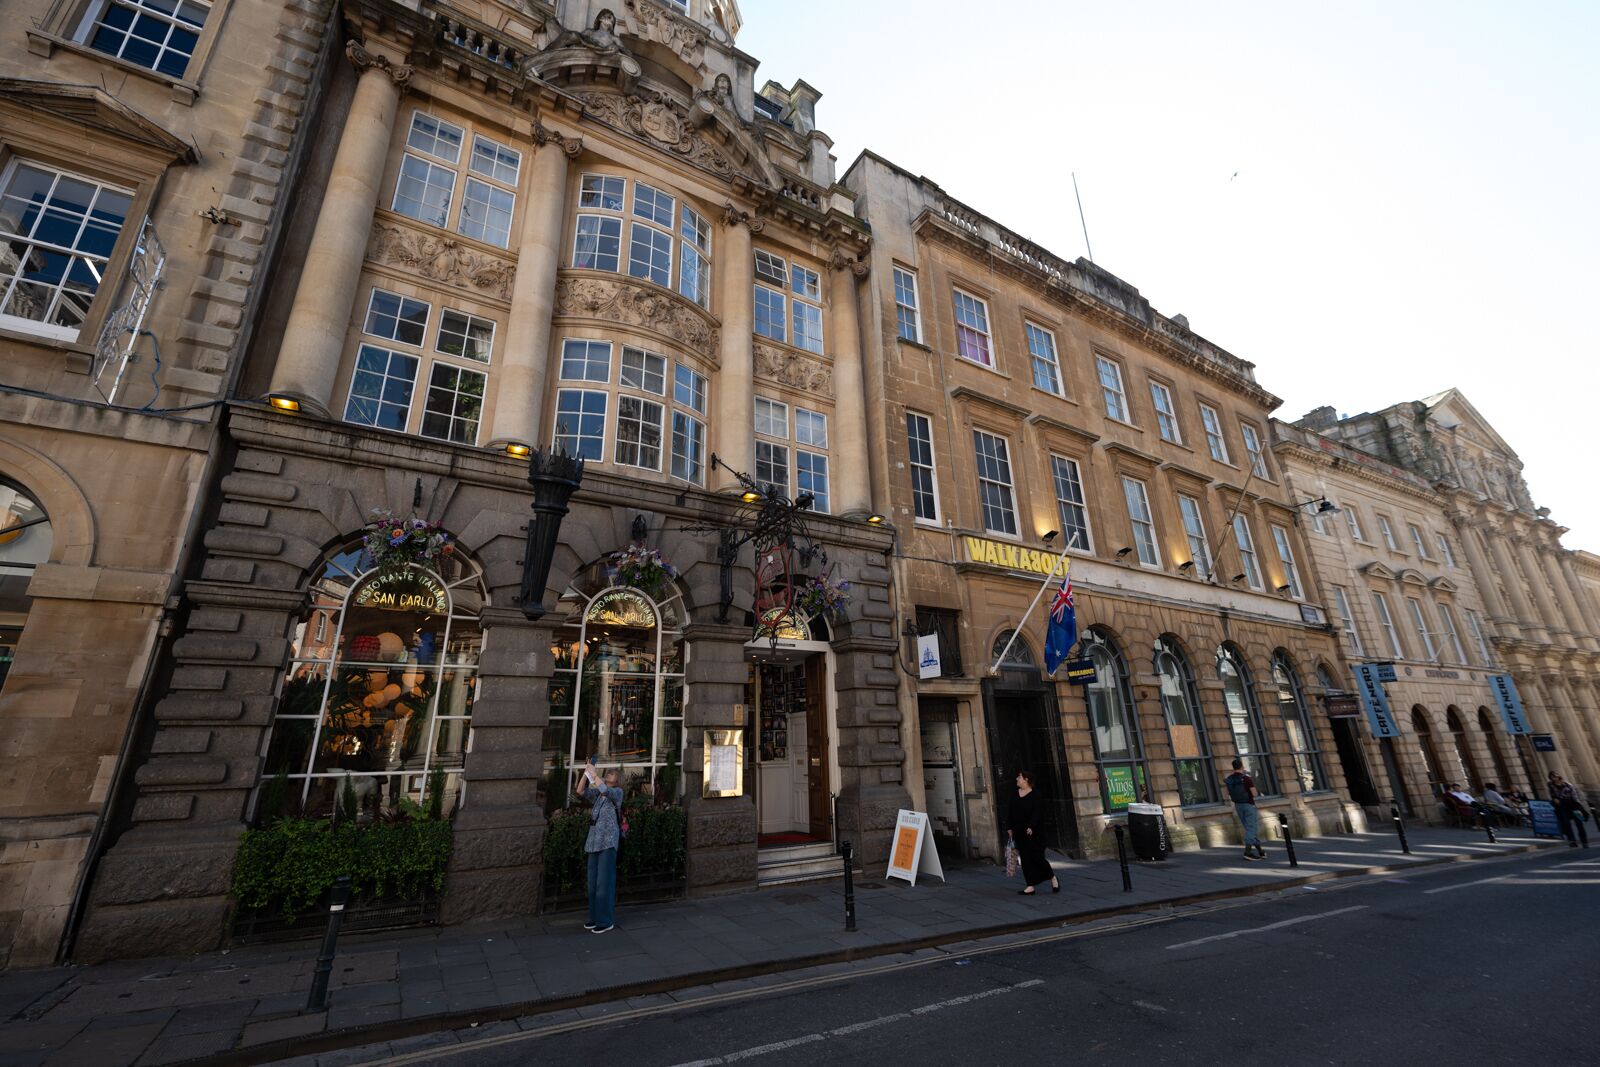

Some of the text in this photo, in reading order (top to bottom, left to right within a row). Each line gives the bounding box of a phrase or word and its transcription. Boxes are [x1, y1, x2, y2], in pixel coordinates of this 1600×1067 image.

[967, 536, 1070, 577] WALKABOUT
[373, 591, 435, 608] SAN CARLO
[418, 575, 446, 610] ITALIANO
[1106, 777, 1134, 797] Wings
